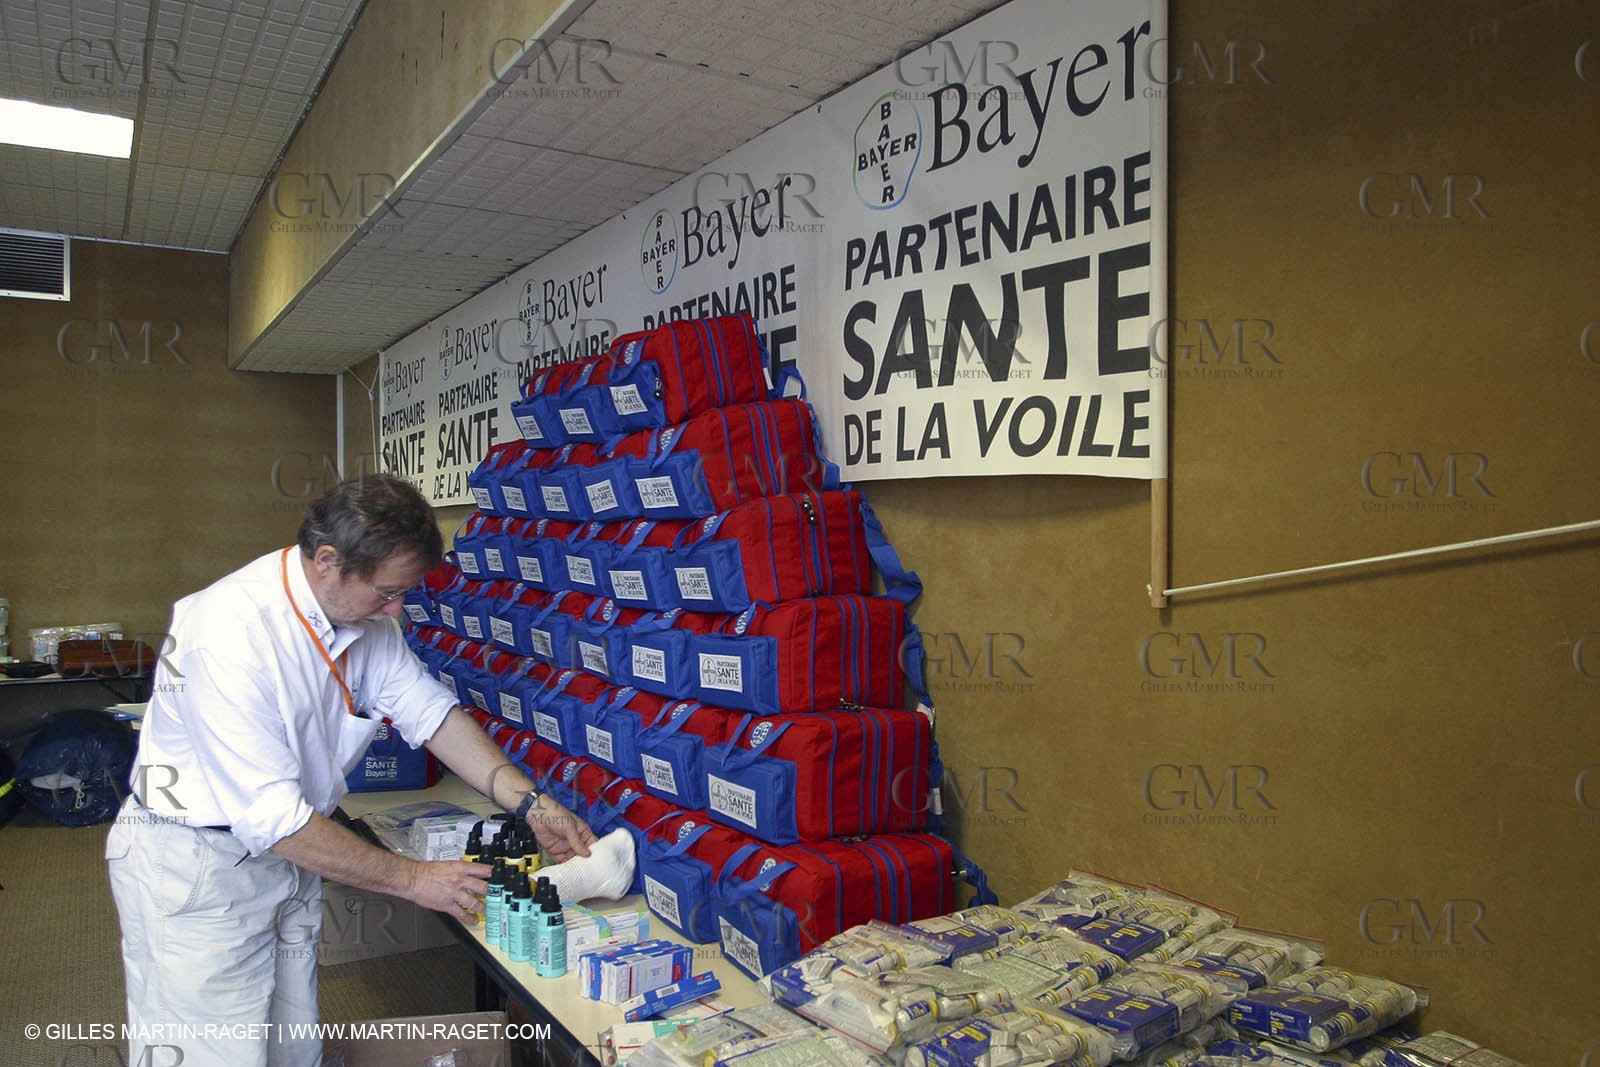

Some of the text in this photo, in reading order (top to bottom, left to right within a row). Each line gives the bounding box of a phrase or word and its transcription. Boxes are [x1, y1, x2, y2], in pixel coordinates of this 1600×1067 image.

[926, 20, 1150, 173] Bayer
[857, 132, 917, 172] BAYER
[877, 100, 895, 204] BAYER
[681, 176, 792, 270] Bayer
[844, 150, 1151, 291] PARTENAIRE
[642, 238, 676, 265] BAYER
[543, 263, 607, 330] Bayer
[842, 241, 1151, 401] SANTE
[454, 318, 497, 370] Bayer
[395, 356, 425, 398] Bayer
[438, 371, 498, 417] PARTENAIRE
[382, 400, 425, 436] PARTENAIRE
[436, 407, 499, 470] SANTE
[845, 389, 1151, 467] DE LA VOILE
[382, 430, 425, 477] SANTE
[433, 474, 445, 500] DE
[447, 472, 461, 498] LA
[654, 487, 673, 497] SANTE
[645, 659, 663, 671] SANTE
[717, 667, 739, 680] SANTE
[365, 769, 387, 778] Bayer
[366, 761, 397, 769] SANTE
[728, 794, 753, 813] SANTE
